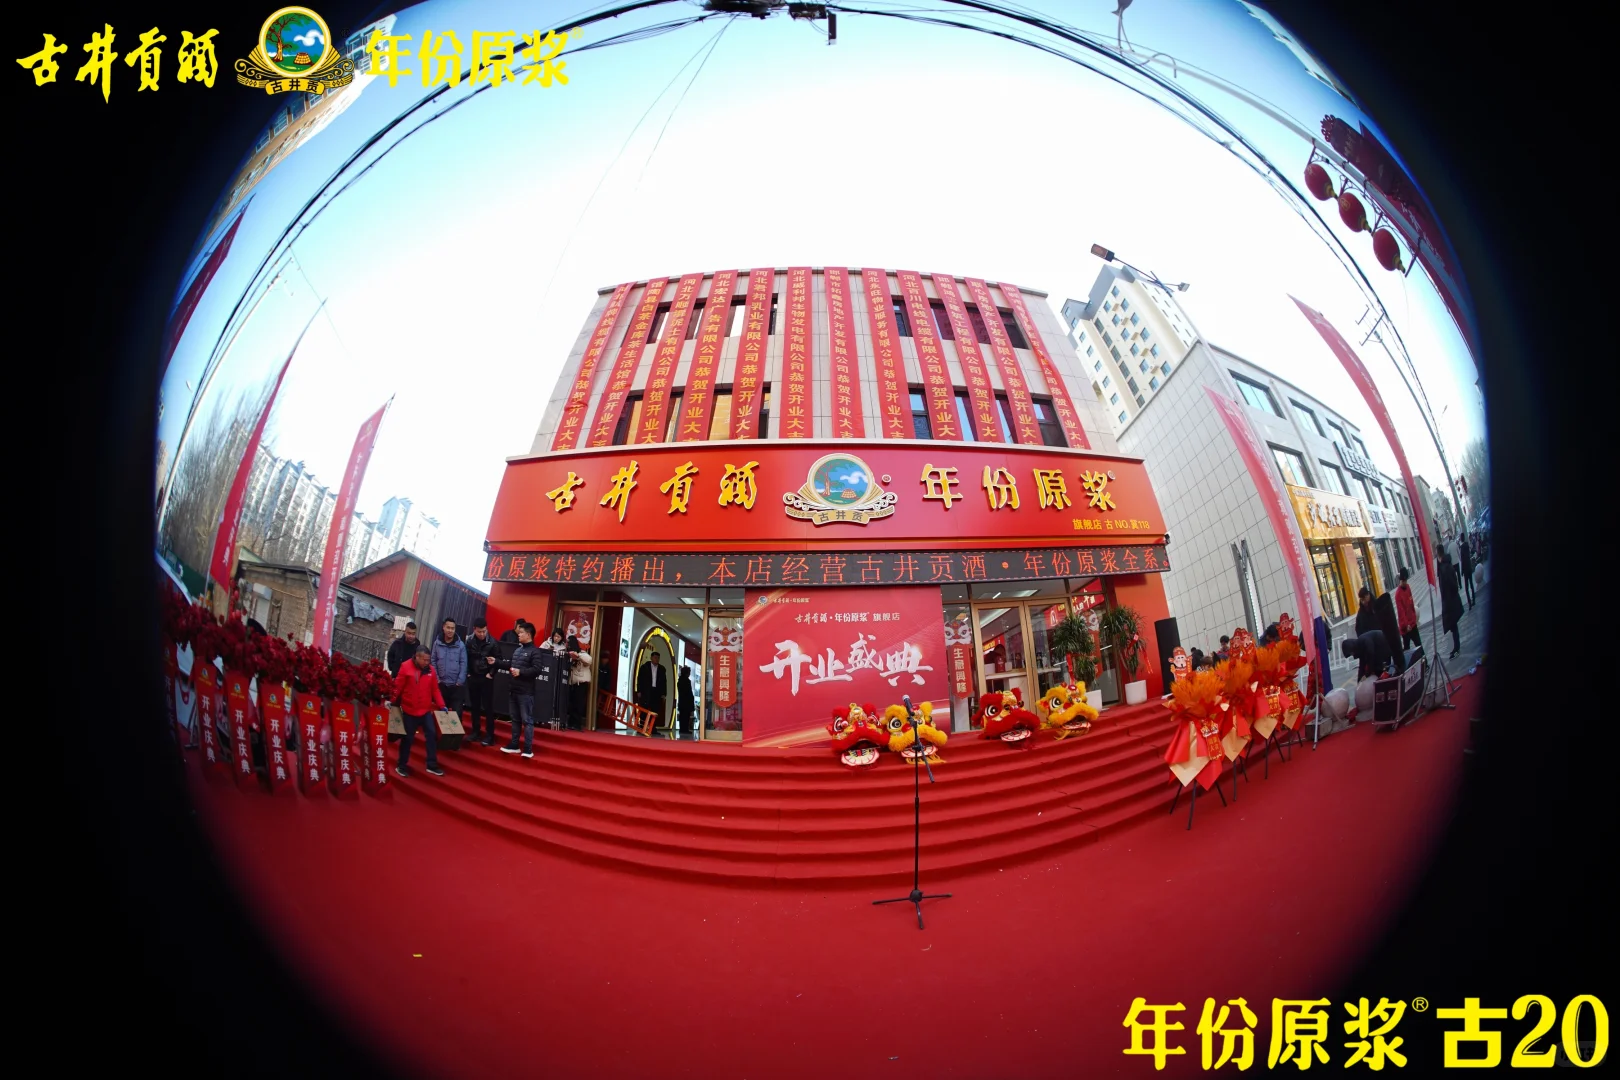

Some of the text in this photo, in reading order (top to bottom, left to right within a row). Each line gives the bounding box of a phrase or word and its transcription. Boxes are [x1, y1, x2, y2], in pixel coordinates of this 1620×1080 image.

[683, 272, 732, 442] 河北宏达广告有限公司恭贺开业大
[545, 460, 759, 522] 古井贡酒
[817, 509, 864, 524] 古井贡
[759, 632, 933, 697] 开业盛典
[202, 696, 216, 763] 开业庆典
[235, 709, 251, 774] 开业庆典
[270, 719, 286, 781] 开业庆典
[306, 724, 319, 782] 开业庆典
[339, 731, 351, 785] 开业庆典
[375, 734, 387, 784] 开业庆典
